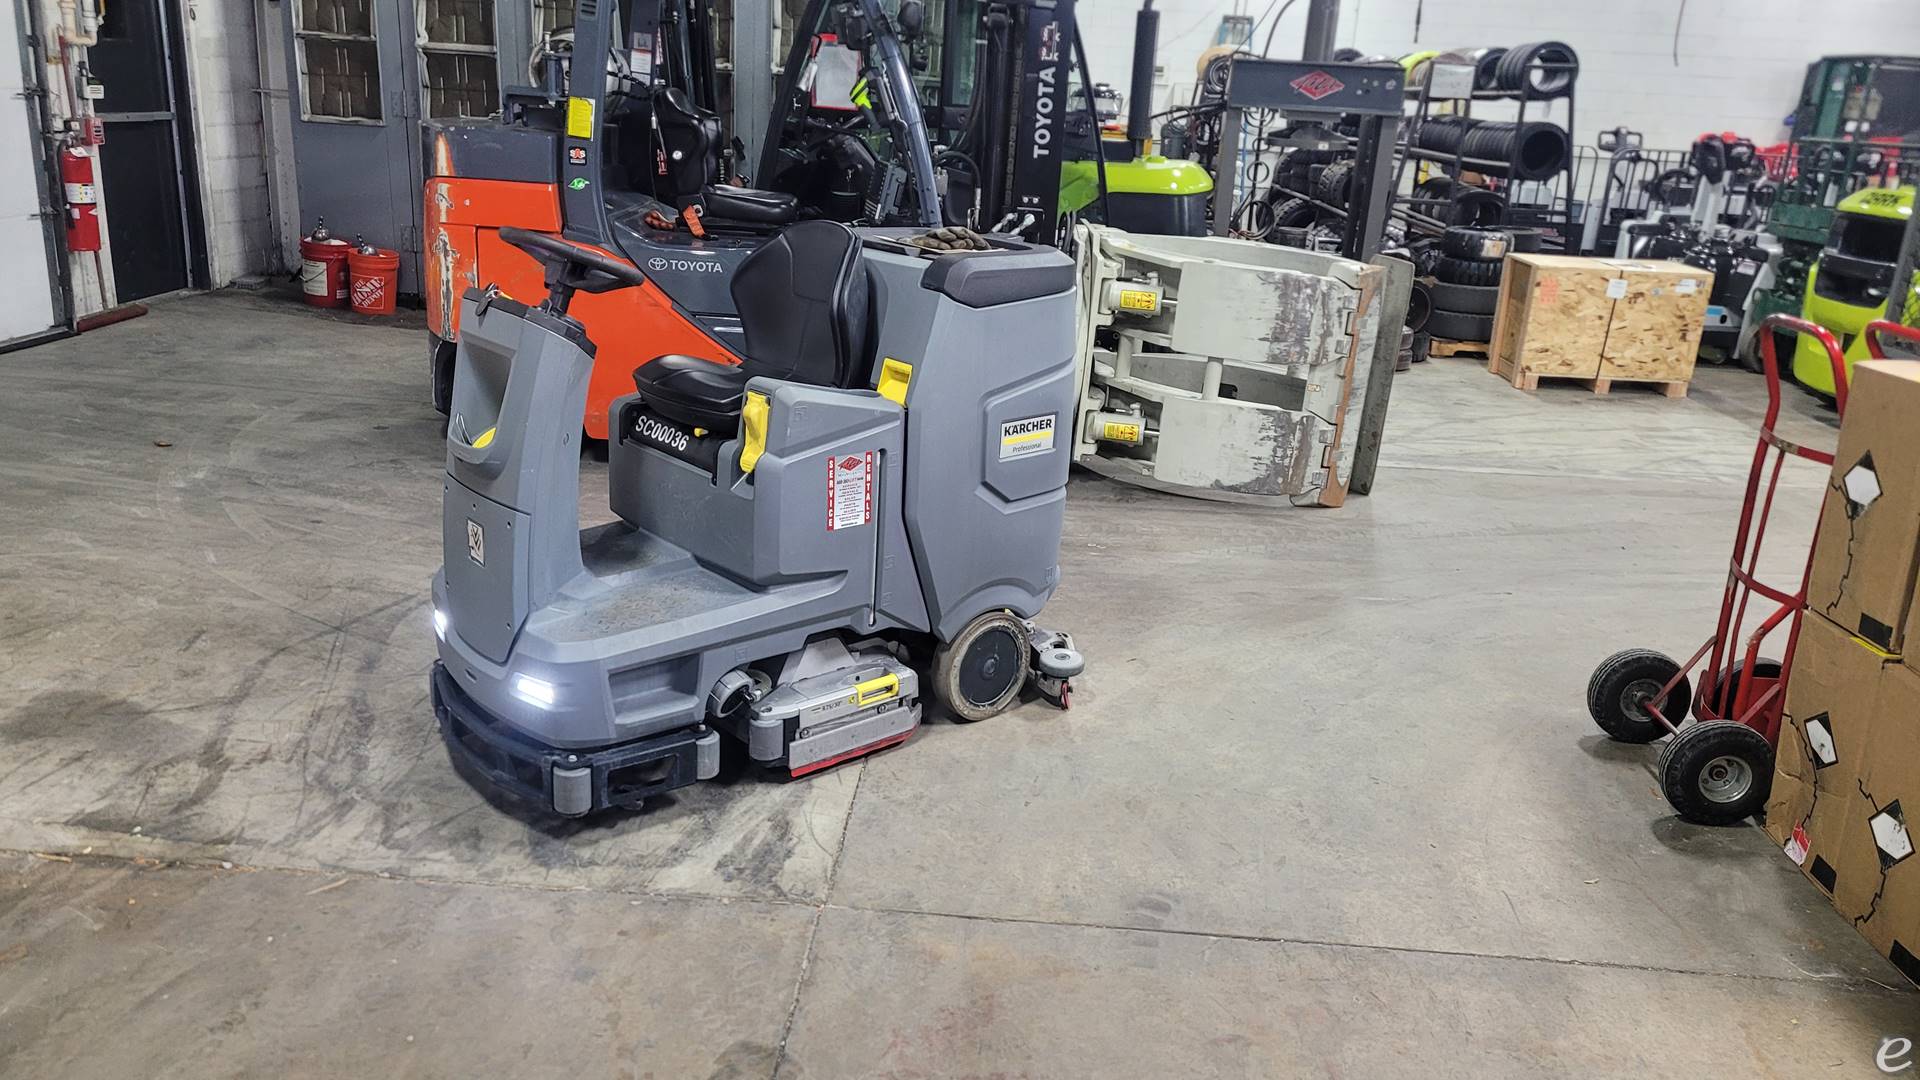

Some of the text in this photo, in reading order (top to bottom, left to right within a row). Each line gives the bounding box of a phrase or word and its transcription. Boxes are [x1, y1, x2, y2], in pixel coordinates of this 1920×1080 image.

[1033, 66, 1056, 159] TOYOTA
[669, 259, 723, 273] TOYOTA
[351, 276, 384, 305] HOME
[635, 415, 690, 452] SC00036
[1004, 418, 1052, 437] KÄRCHER
